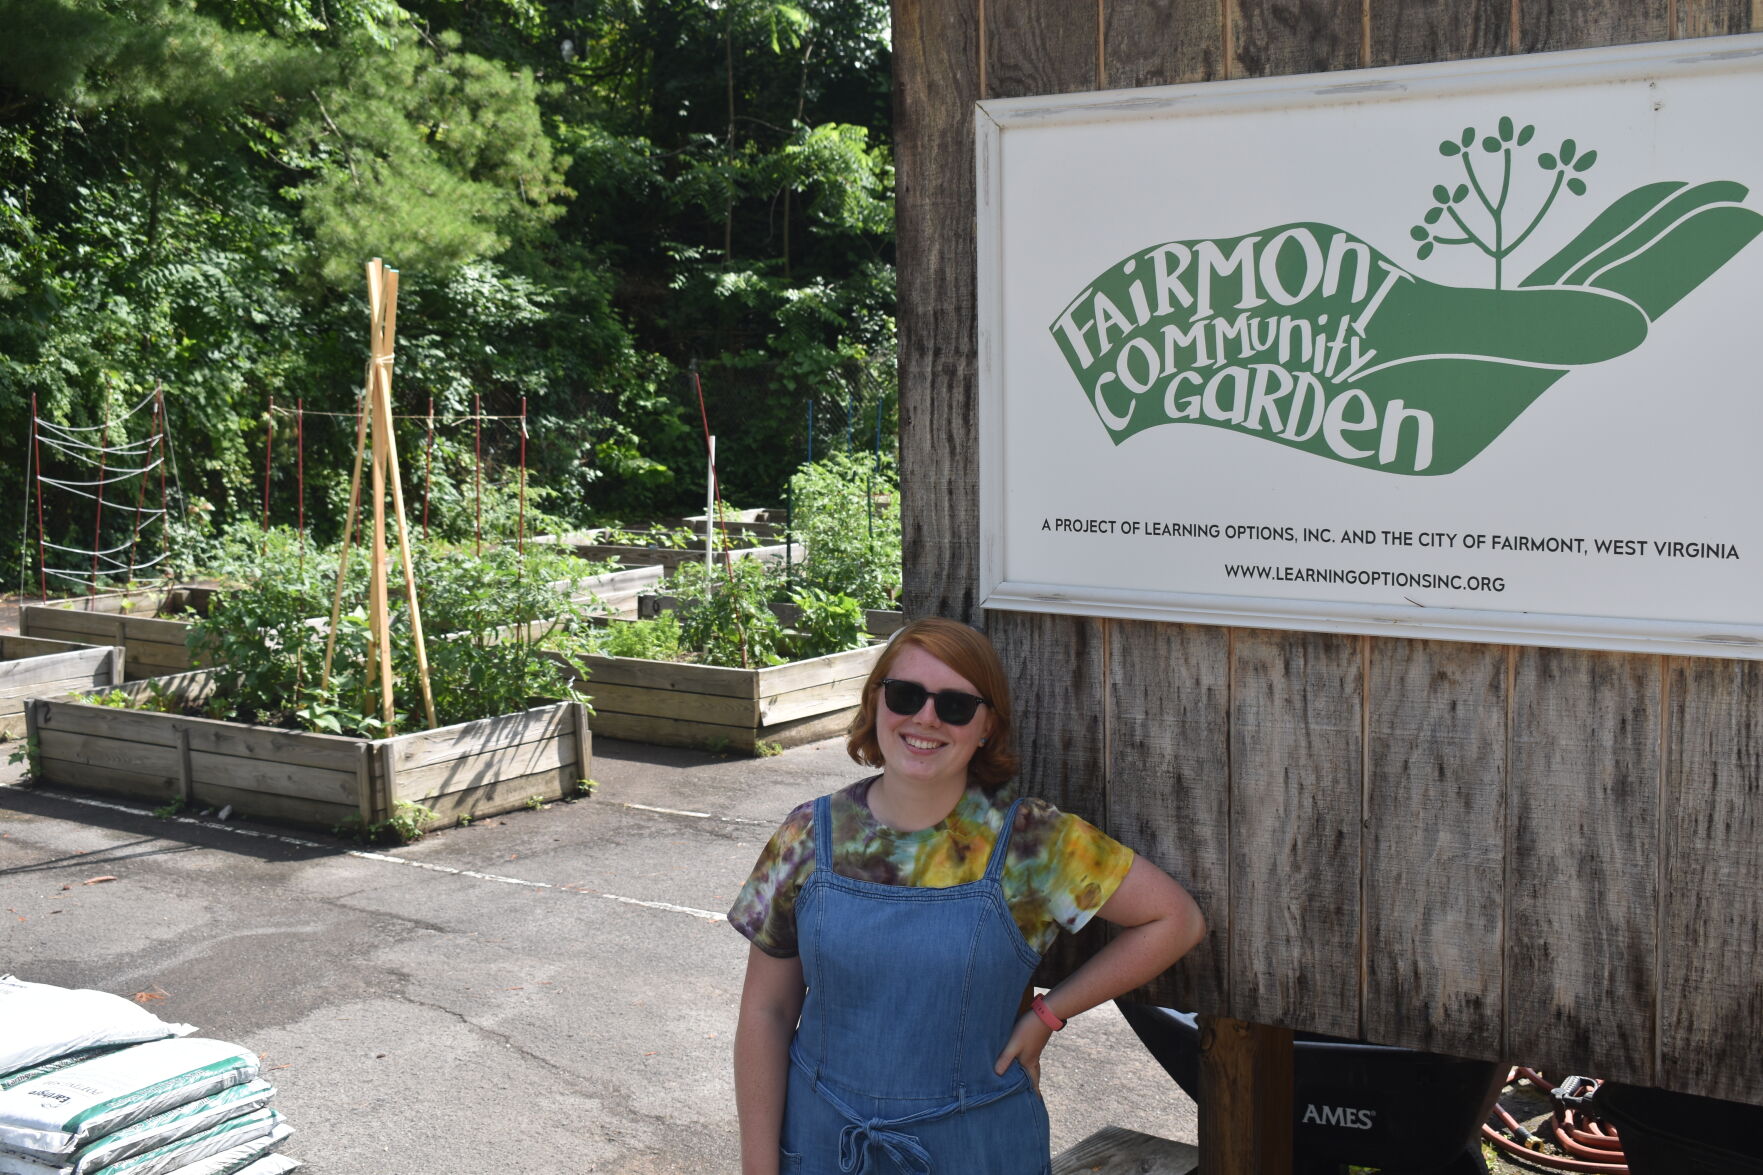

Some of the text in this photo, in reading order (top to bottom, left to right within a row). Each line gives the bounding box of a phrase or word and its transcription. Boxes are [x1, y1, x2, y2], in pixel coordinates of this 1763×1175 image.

[1041, 518, 1740, 560] A PROJECT OF LEARNING OPTIONS, INC. AND THE CITY OF FAIRMONT, WEST VIRGINIA
[1224, 564, 1505, 592] WWW.LEARNINGOPTIONSINC.ORG
